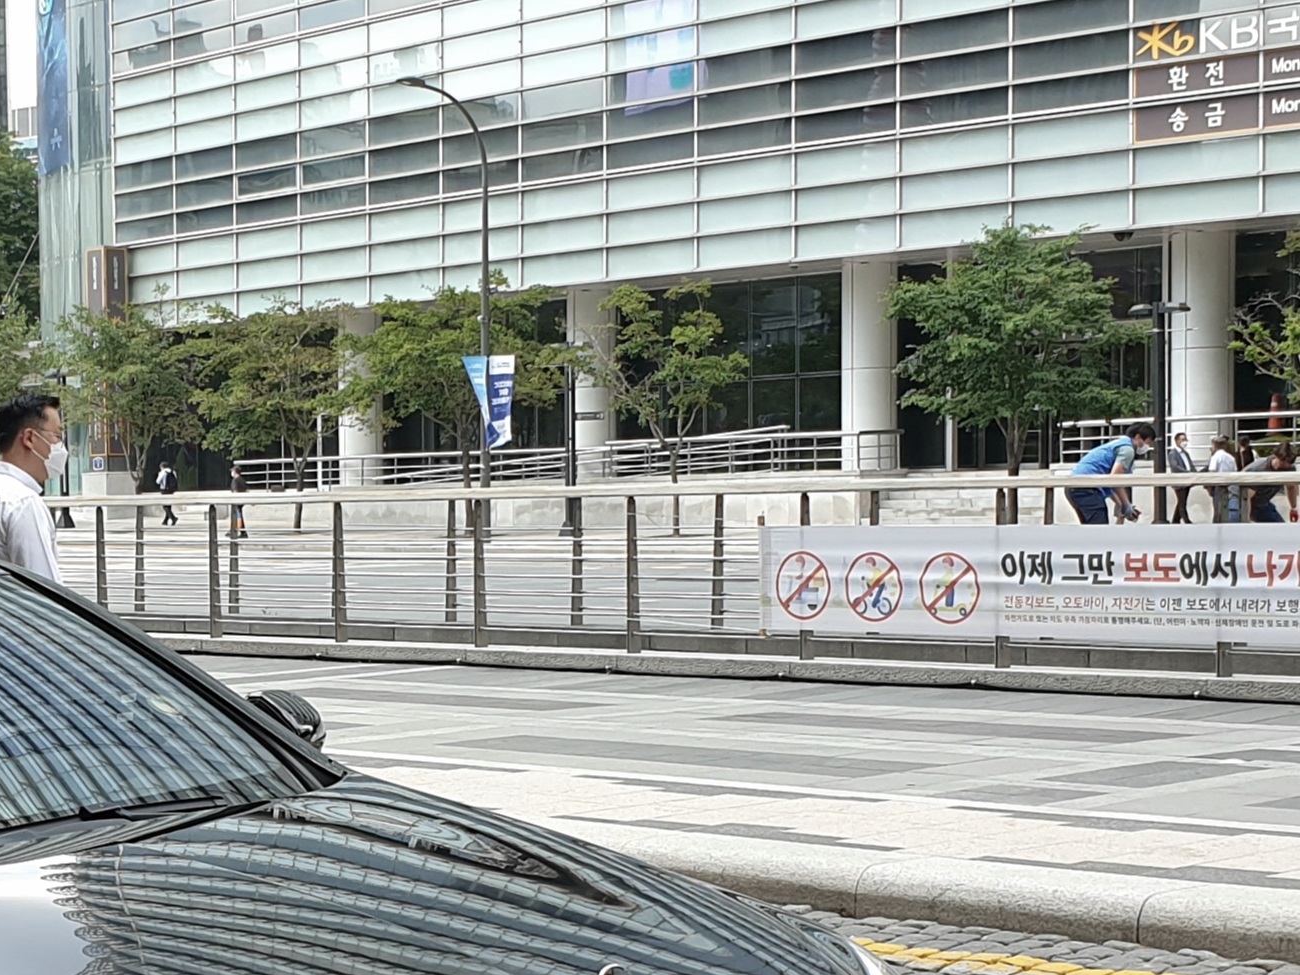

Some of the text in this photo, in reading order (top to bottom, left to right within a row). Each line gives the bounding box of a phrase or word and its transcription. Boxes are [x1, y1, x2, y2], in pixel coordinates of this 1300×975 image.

[1001, 551, 1054, 585] 이제
[1061, 551, 1115, 585] 그만
[1123, 551, 1238, 587] 보도에서
[1061, 595, 1108, 612] 오토바이,
[1111, 596, 1156, 611] 자전거는
[1159, 597, 1182, 611] 이젠
[1185, 597, 1232, 613] 보도에서
[1236, 598, 1271, 613] 내려가
